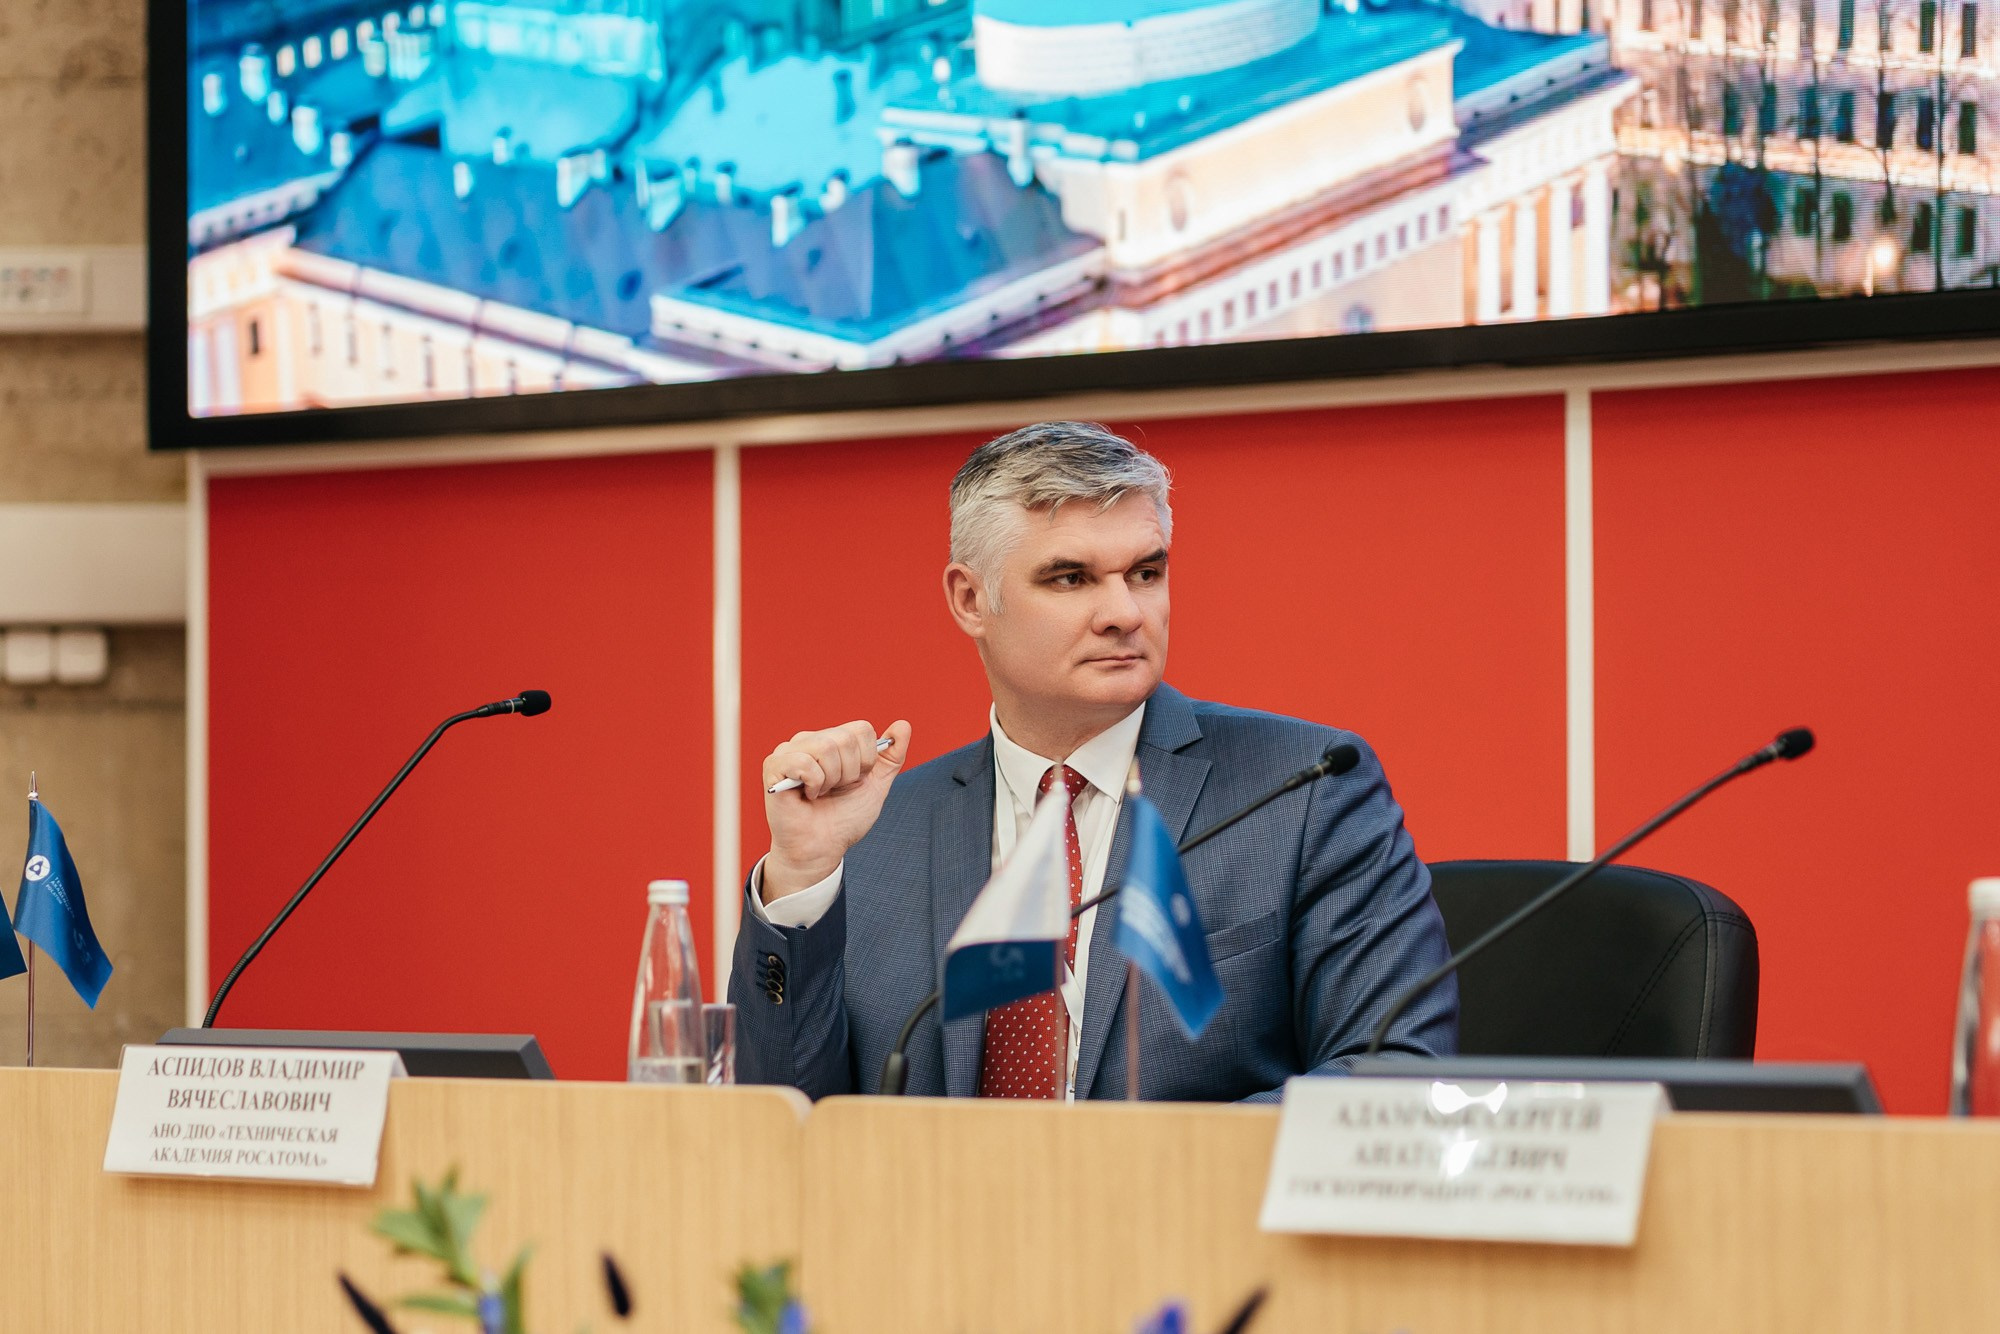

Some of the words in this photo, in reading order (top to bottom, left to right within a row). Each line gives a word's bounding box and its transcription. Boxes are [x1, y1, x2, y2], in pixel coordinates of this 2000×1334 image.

[147, 1057, 244, 1079] АСПИДОВ
[249, 1059, 365, 1081] ВЛАДИМИР
[167, 1089, 332, 1113] ВЯЧЕСЛАВОВИЧ
[149, 1123, 180, 1138] АНО
[183, 1124, 215, 1140] ДПО
[219, 1125, 339, 1143] «ТЕХНИЧЕСКАЯ
[150, 1147, 232, 1164] АКАДЕМИЯ
[236, 1149, 327, 1167] РОСАТОМА»
